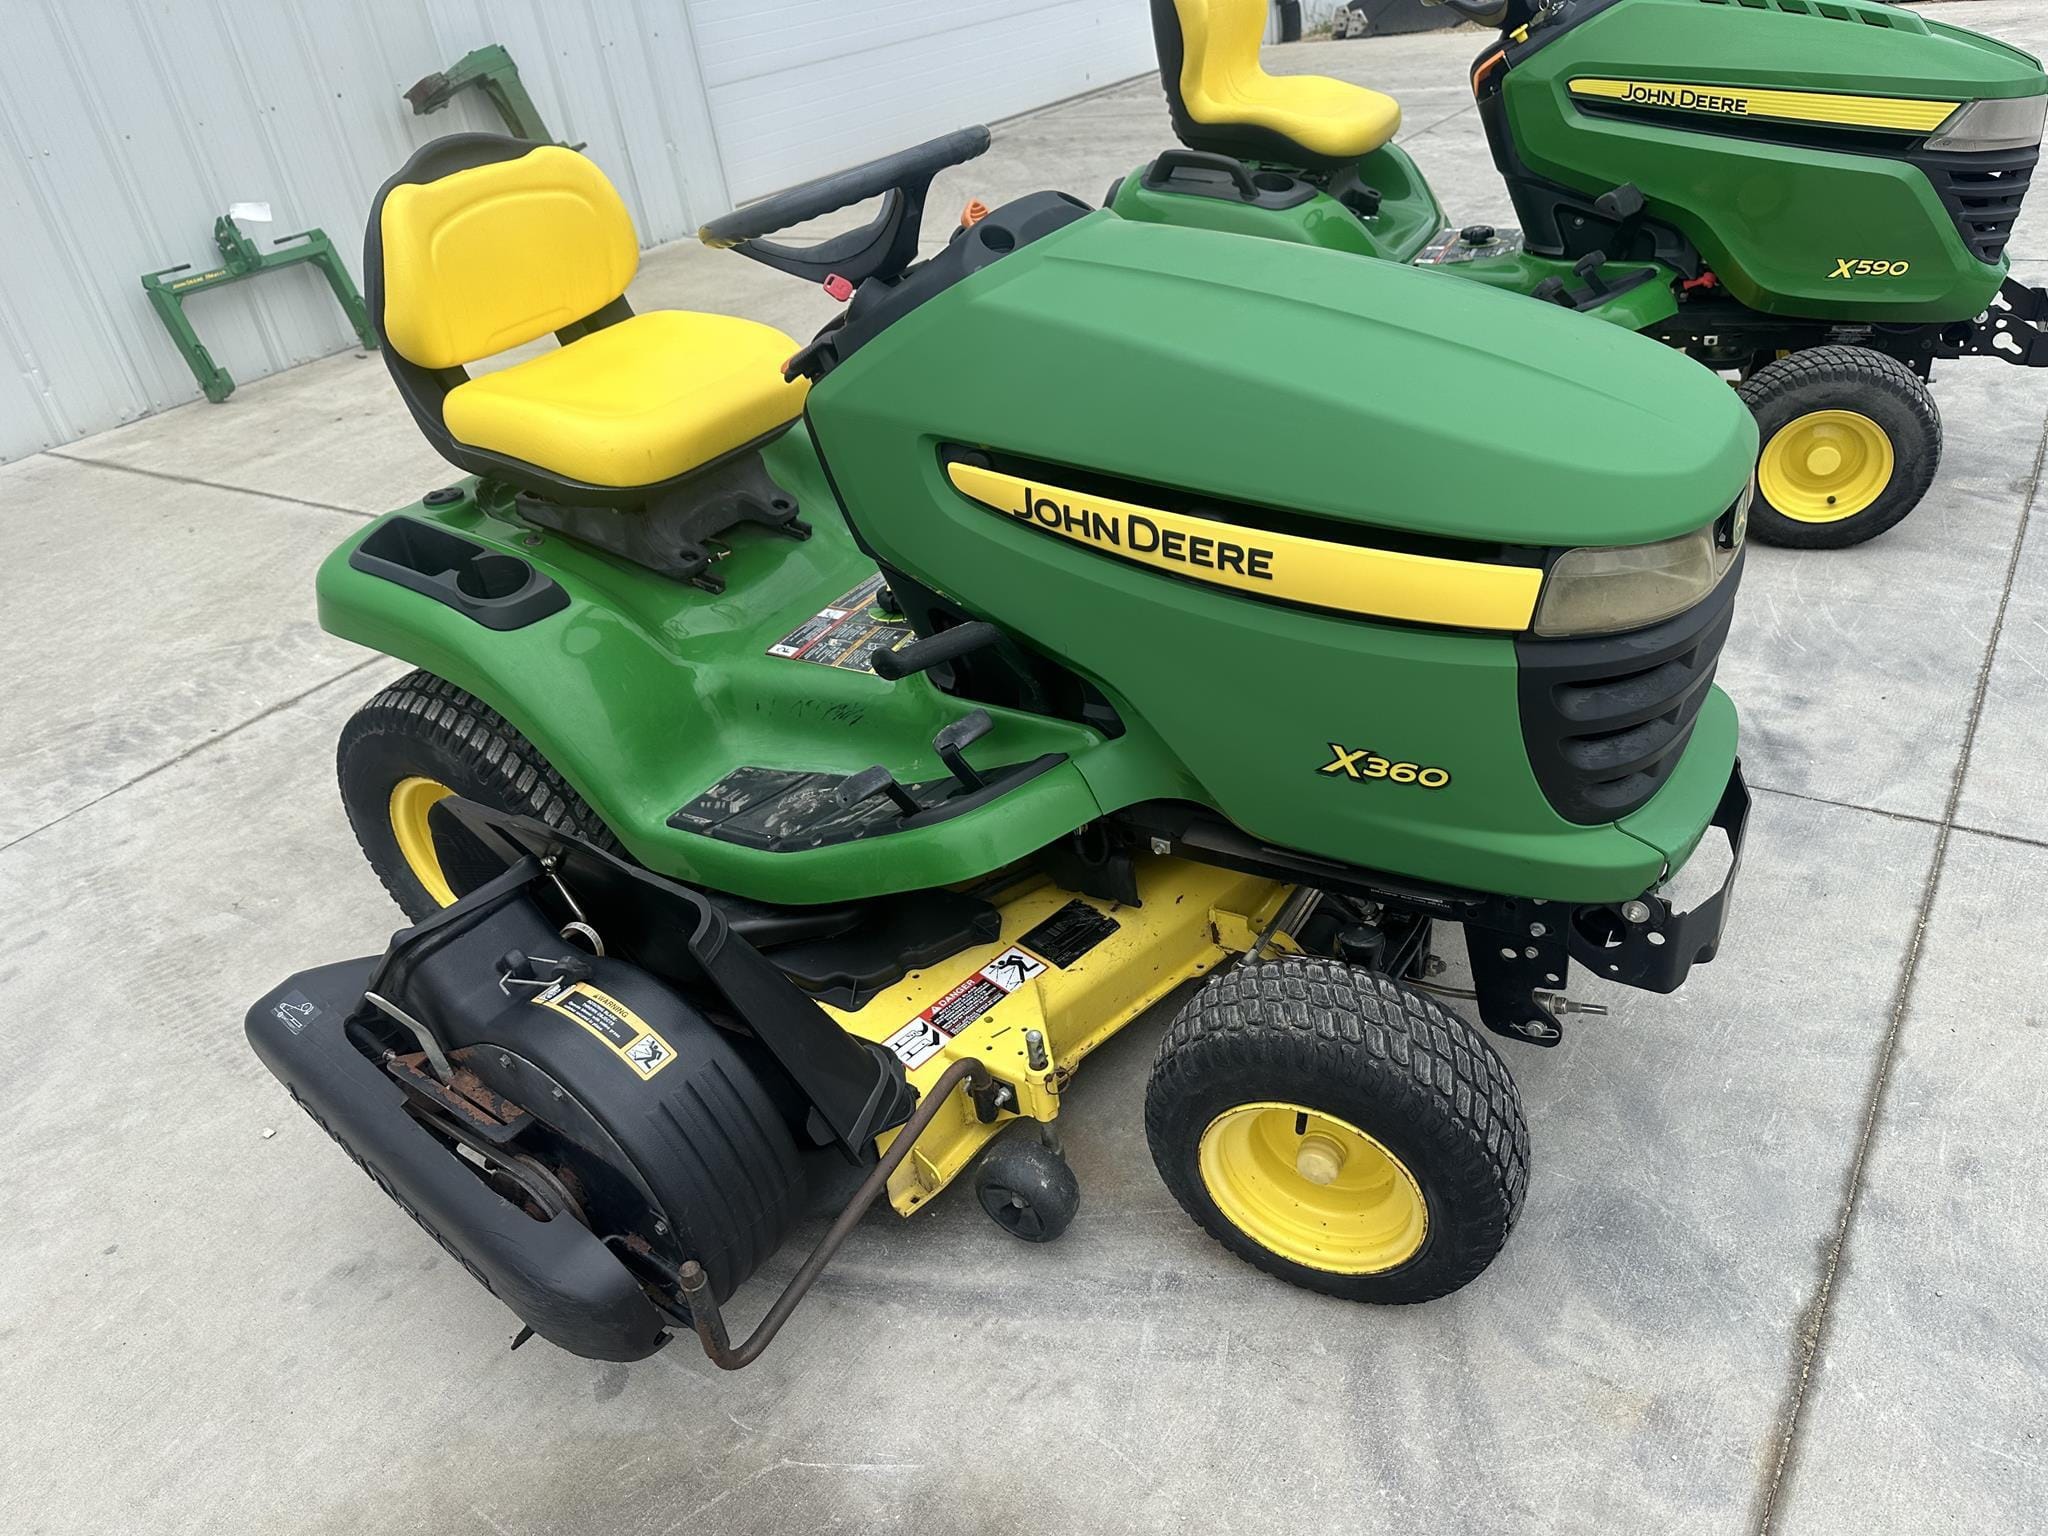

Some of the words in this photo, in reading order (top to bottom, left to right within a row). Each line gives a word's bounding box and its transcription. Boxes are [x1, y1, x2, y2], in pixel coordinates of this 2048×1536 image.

[1621, 83, 1676, 105] JOHN
[1679, 89, 1748, 114] DEERE
[1825, 258, 1910, 279] X590
[1013, 487, 1120, 546] JOHN
[1128, 514, 1274, 580] DEERE
[1317, 743, 1450, 788] X360
[598, 994, 629, 1018] WARNING
[938, 979, 976, 1005] DANGER
